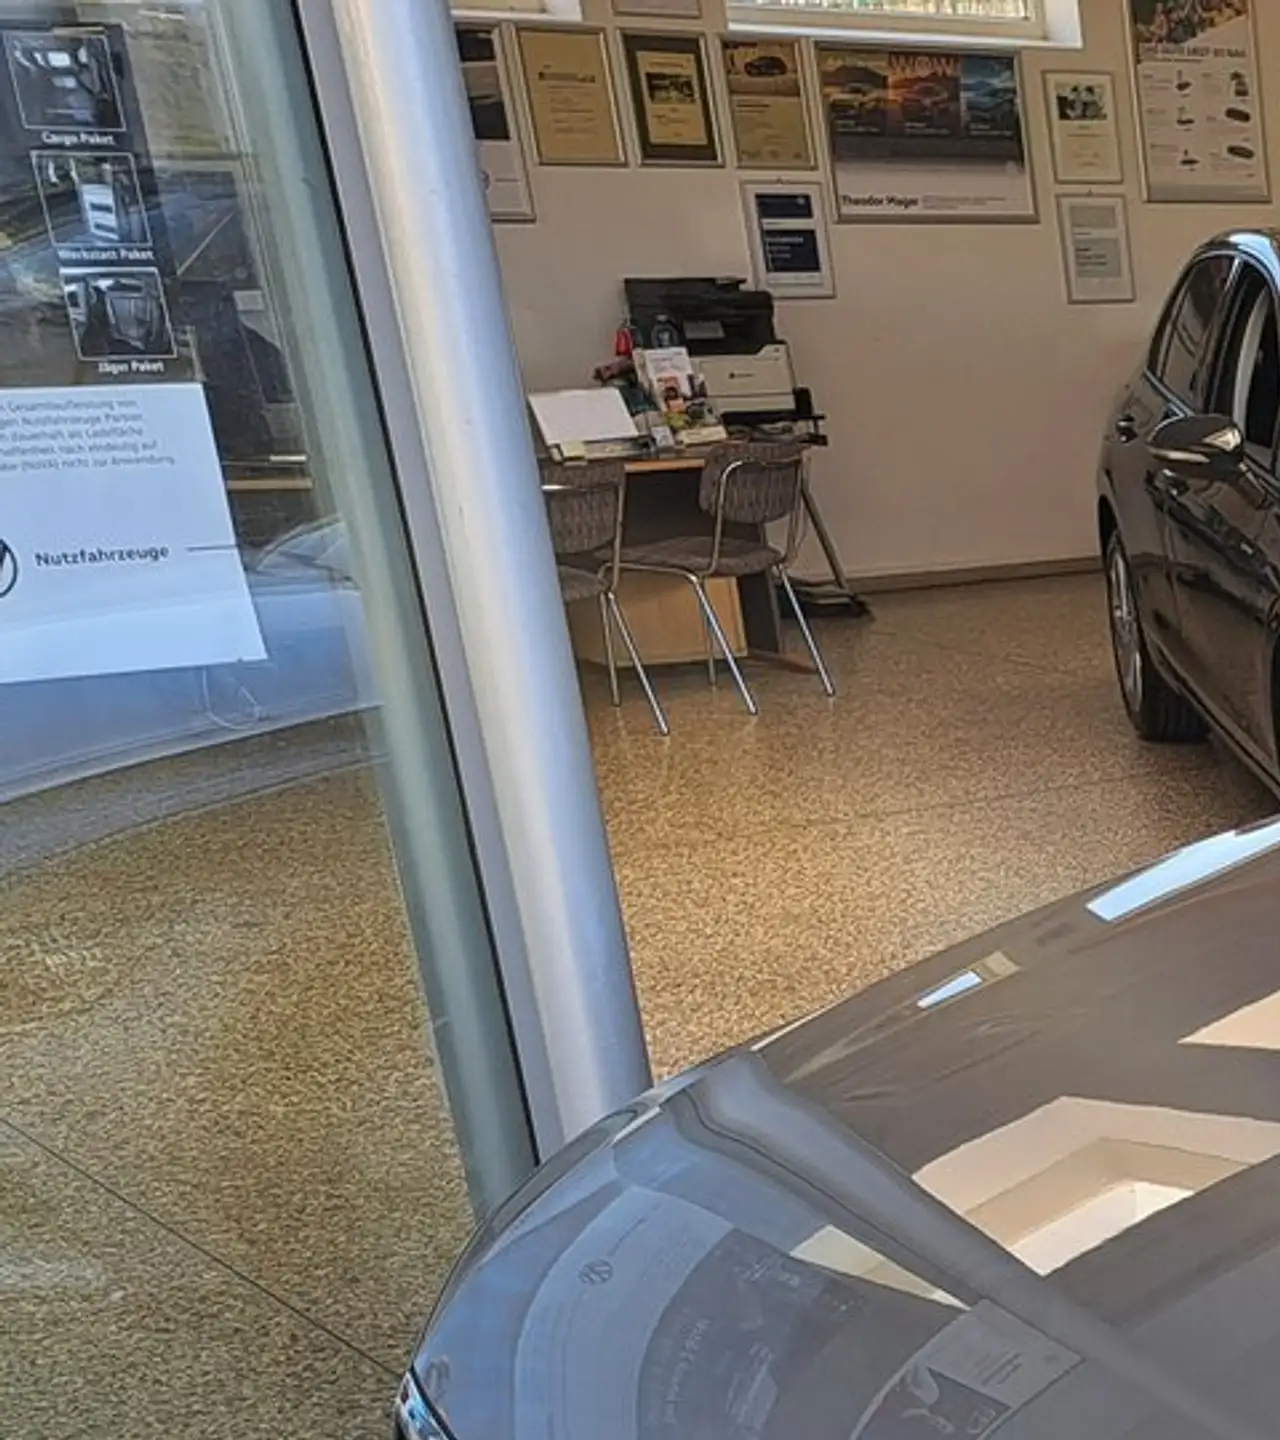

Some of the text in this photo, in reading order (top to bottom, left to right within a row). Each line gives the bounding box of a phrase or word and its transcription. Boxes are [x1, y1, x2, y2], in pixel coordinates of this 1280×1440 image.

[41, 131, 117, 146] Cargo Paket
[841, 194, 884, 207] Theodor
[119, 249, 155, 261] Paket
[131, 359, 165, 374] Paket
[35, 547, 170, 567] Nutzfahrzeuge
